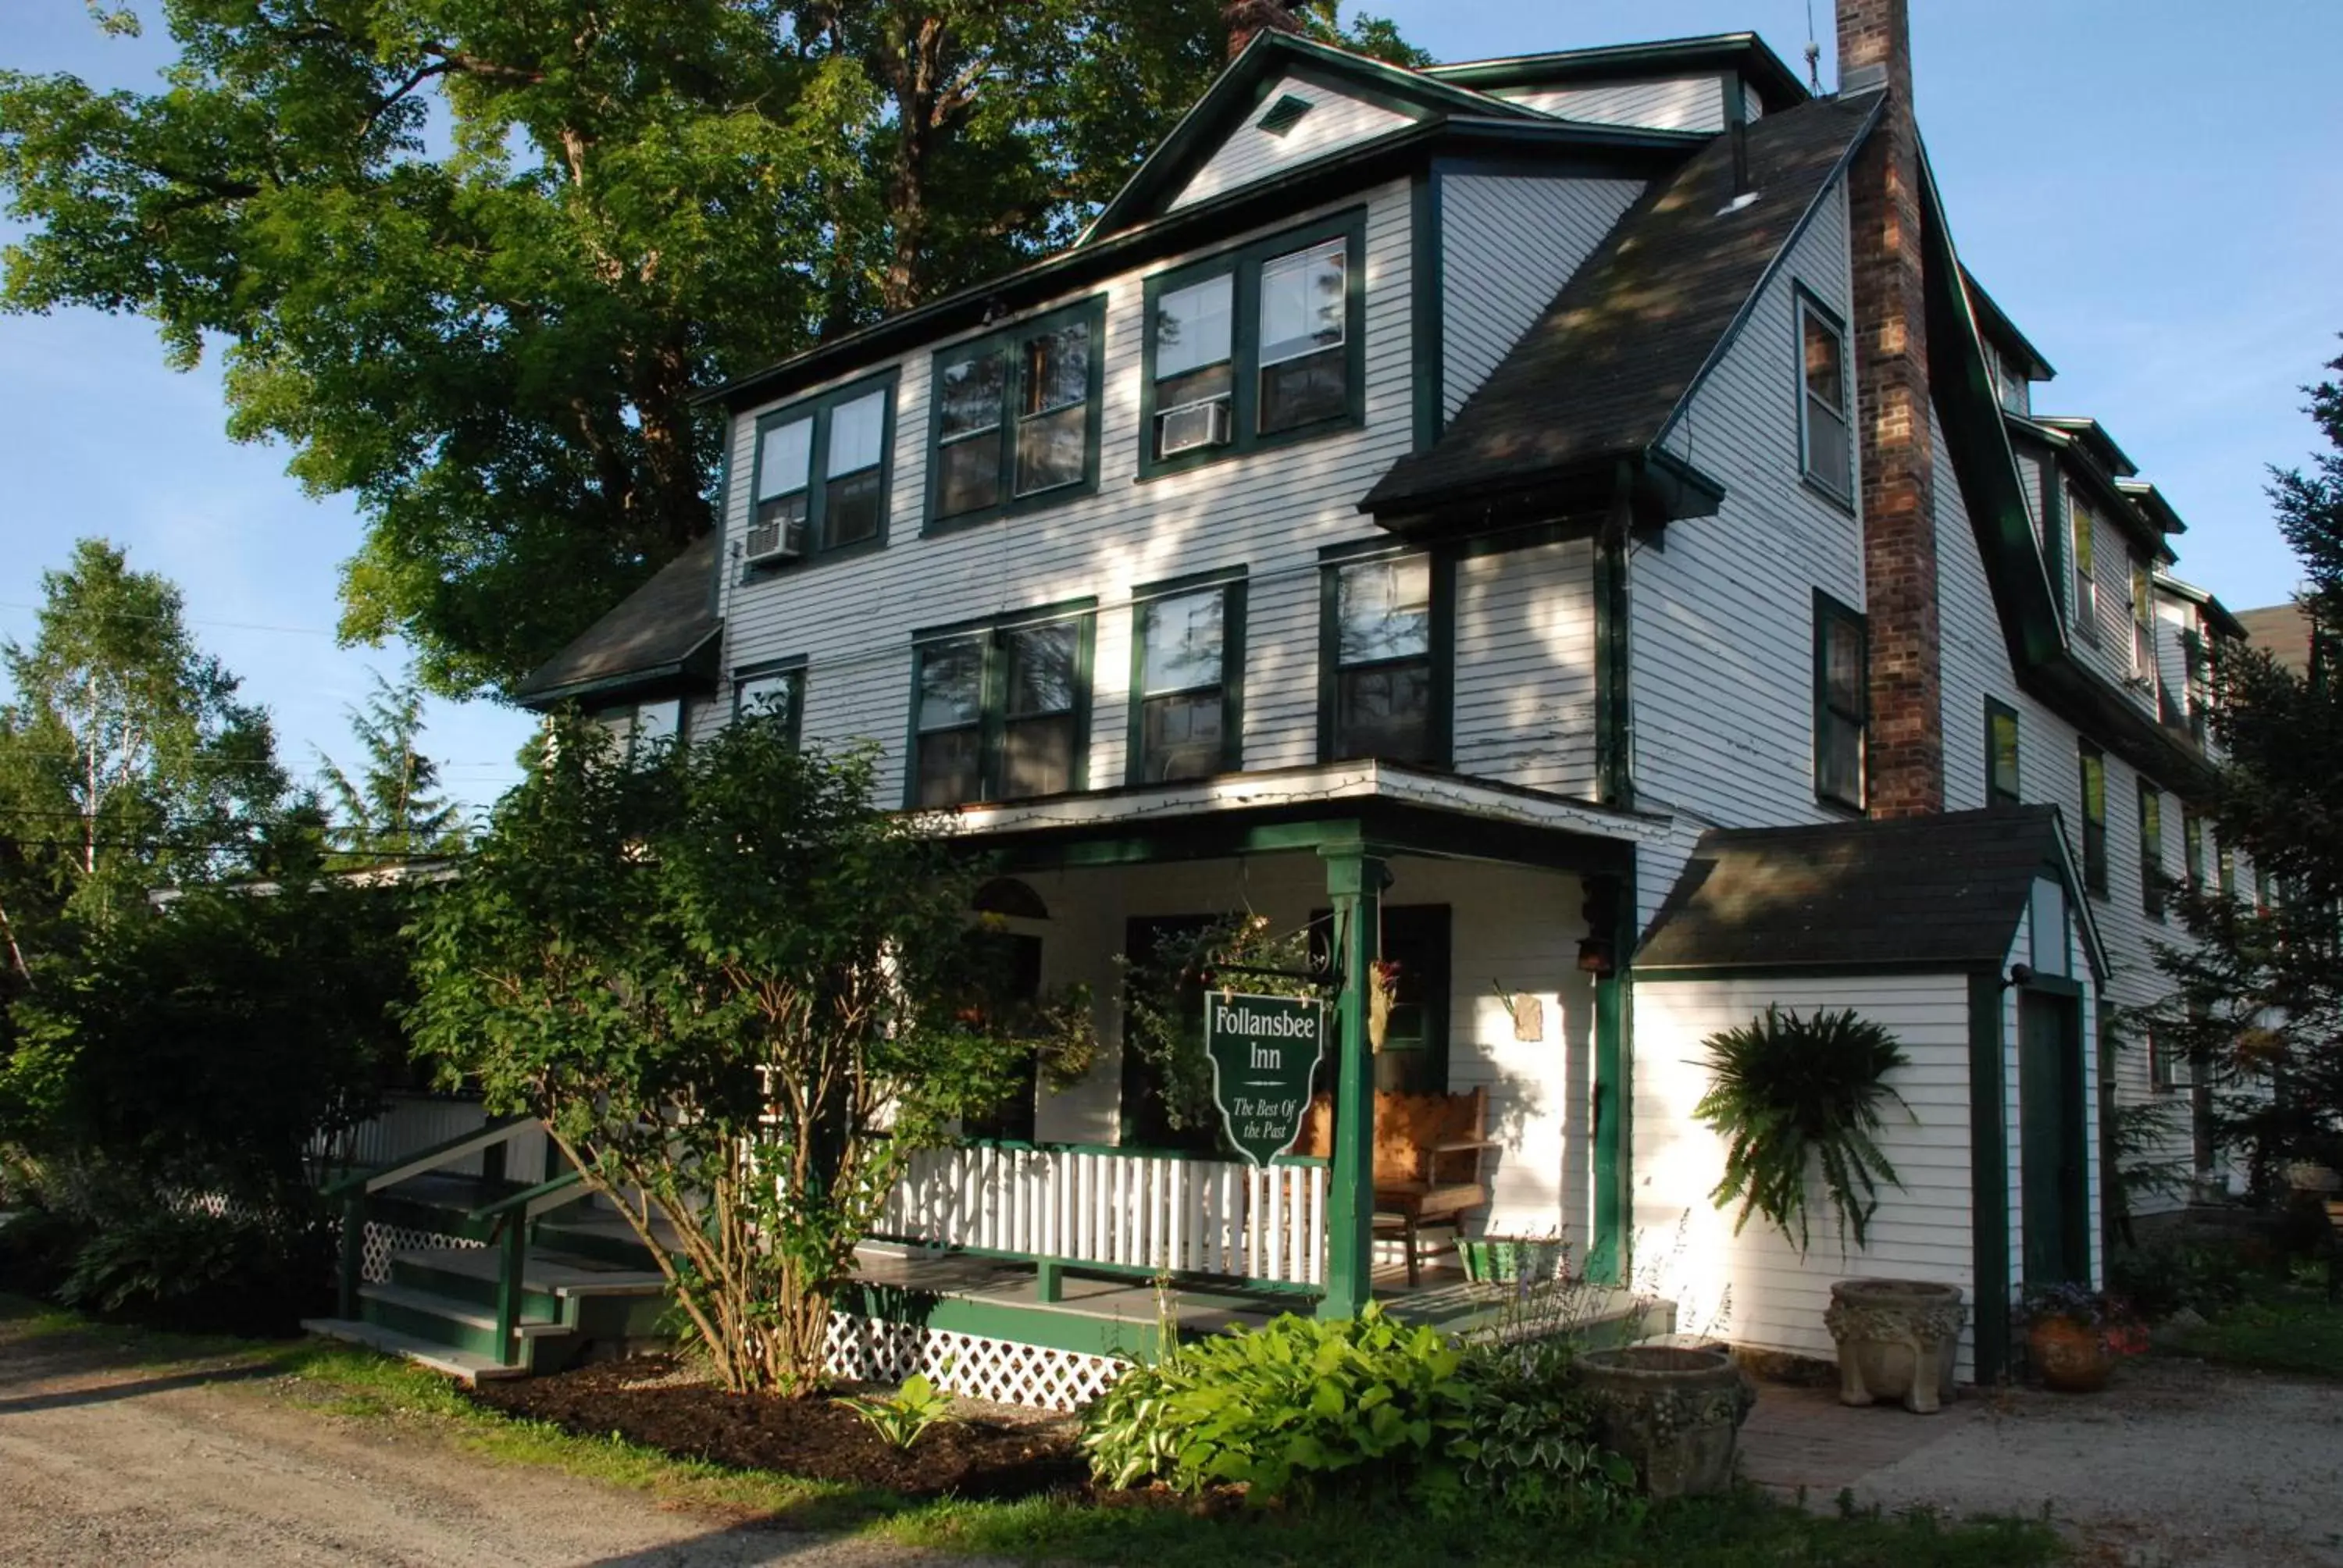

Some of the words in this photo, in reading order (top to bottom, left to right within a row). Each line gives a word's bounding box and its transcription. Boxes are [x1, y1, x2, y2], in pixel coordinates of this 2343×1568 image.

[1216, 1006, 1314, 1038] Follansbee
[1250, 1042, 1281, 1069] Inn
[1234, 1098, 1253, 1117] The
[1256, 1099, 1278, 1117] Best
[1282, 1099, 1297, 1122] Of
[1243, 1121, 1260, 1139] the
[1262, 1121, 1286, 1139] Past
